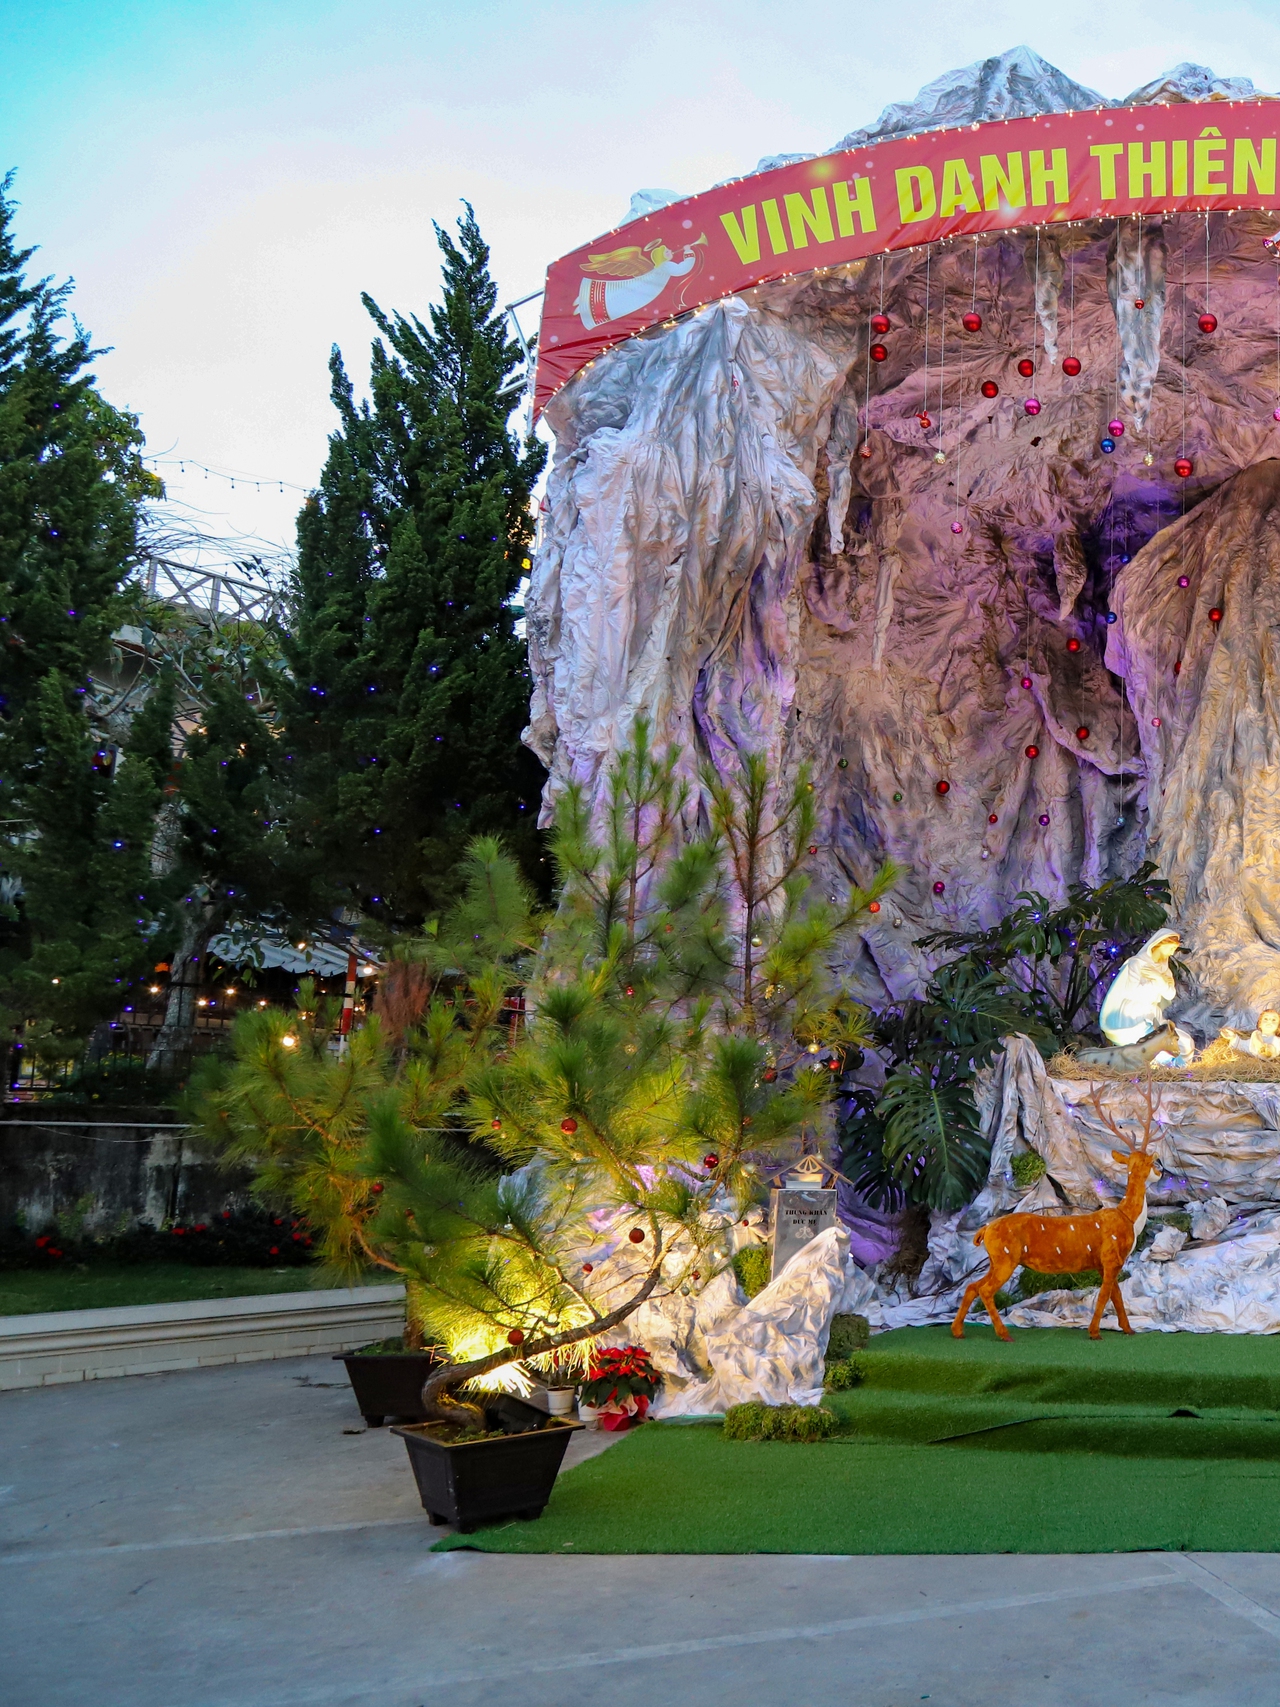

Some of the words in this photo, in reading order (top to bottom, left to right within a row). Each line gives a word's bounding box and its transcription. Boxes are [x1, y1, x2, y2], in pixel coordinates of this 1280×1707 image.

[719, 176, 877, 265] VINH
[895, 147, 1070, 225] DANH
[1089, 126, 1278, 200] THIÊN
